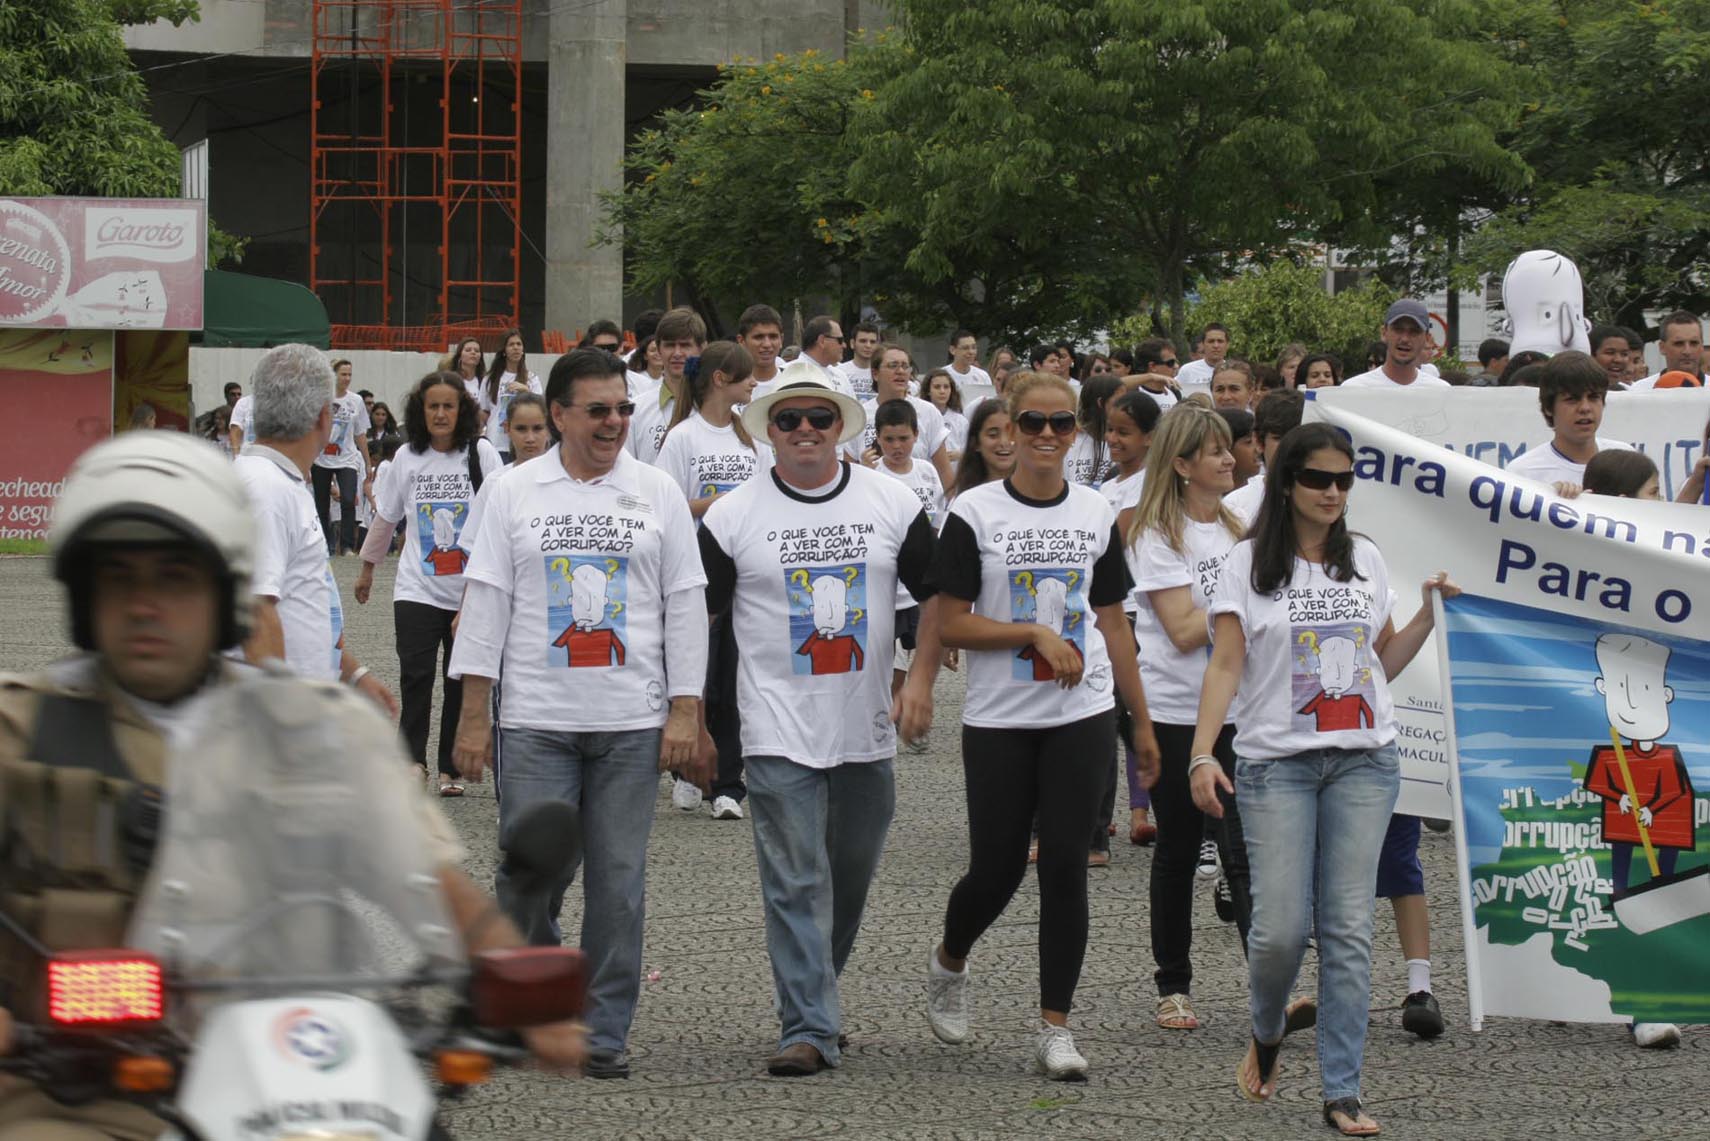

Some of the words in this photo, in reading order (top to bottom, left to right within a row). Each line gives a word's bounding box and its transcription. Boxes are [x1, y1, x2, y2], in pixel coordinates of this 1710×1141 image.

[97, 216, 184, 243] Garoto
[707, 463, 724, 471] VER
[726, 463, 746, 472] COM
[1469, 476, 1637, 544] quem
[531, 517, 540, 528] O
[545, 515, 573, 527] QUE
[619, 517, 645, 531] TEM
[541, 528, 551, 539] A
[557, 526, 585, 538] VER
[588, 527, 619, 539] COM
[623, 529, 633, 541] A
[767, 531, 777, 542] O
[781, 528, 808, 541] QUE
[850, 523, 875, 535] TEM
[993, 533, 1003, 544] O
[1007, 529, 1034, 541] QUE
[1073, 529, 1097, 543] TEM
[779, 542, 789, 552] A
[793, 539, 820, 551] VER
[824, 536, 853, 549] COM
[857, 535, 867, 546] A
[1006, 542, 1015, 553] A
[1019, 540, 1045, 551] VER
[1049, 540, 1077, 551] COM
[1079, 542, 1088, 552] A
[1495, 539, 1632, 612] Para
[1656, 588, 1692, 624] o
[1287, 589, 1314, 600] QUE
[1288, 600, 1297, 611] A
[1301, 599, 1328, 611] VER
[1332, 598, 1360, 610] COM
